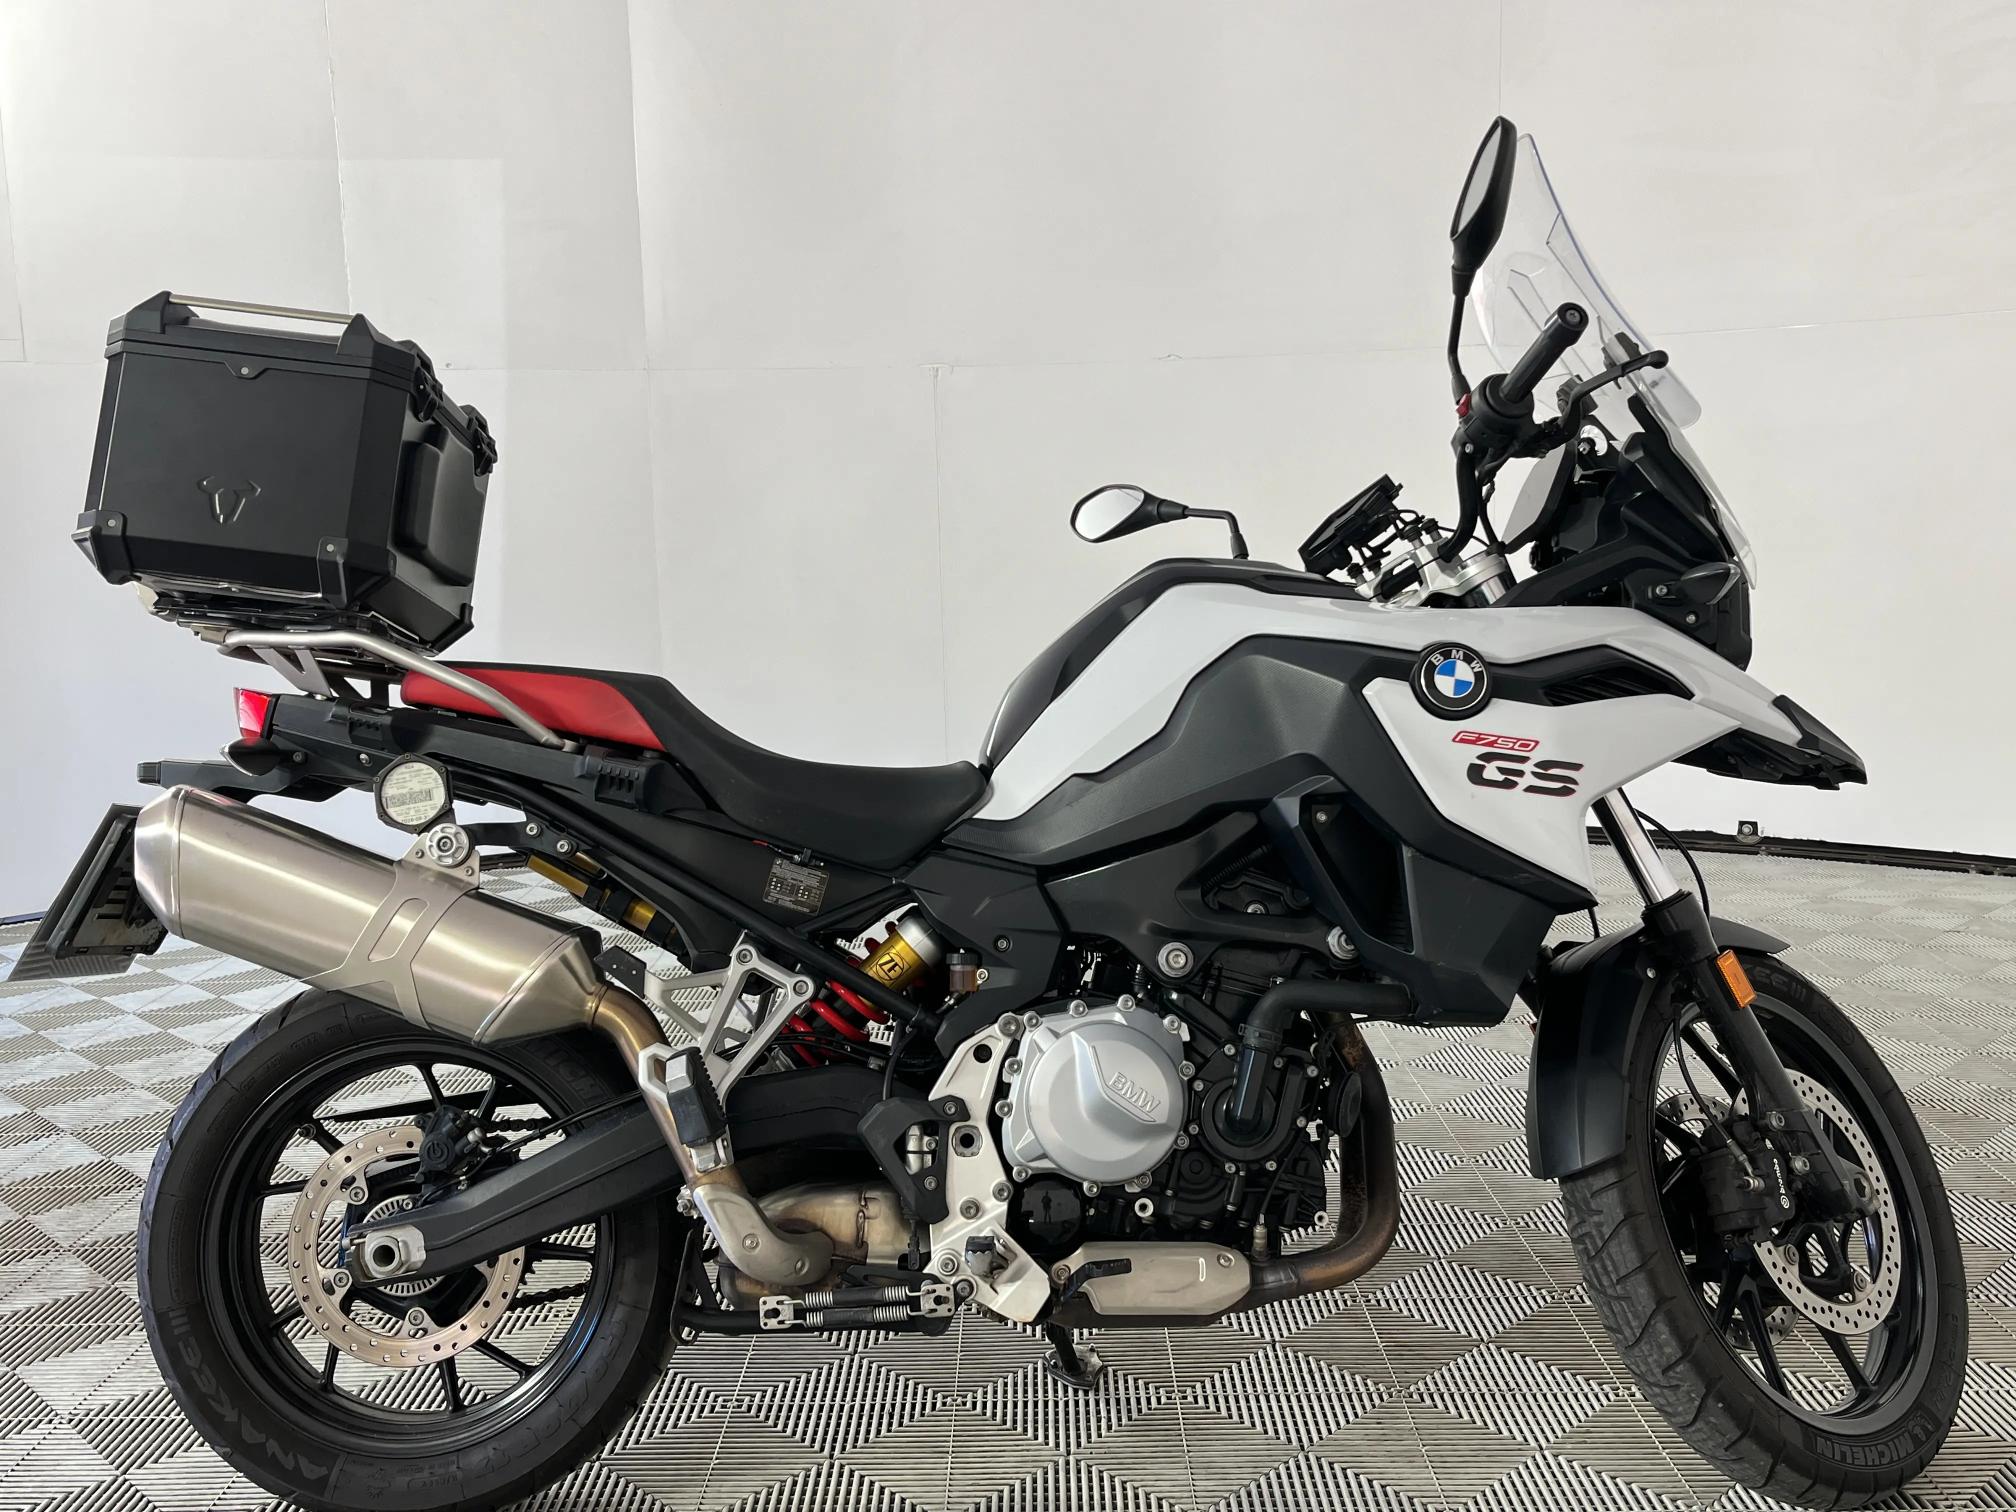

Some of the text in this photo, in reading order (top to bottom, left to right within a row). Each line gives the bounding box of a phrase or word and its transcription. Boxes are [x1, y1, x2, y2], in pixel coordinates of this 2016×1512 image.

[1431, 649, 1484, 673] BMW
[1455, 732, 1537, 751] F750
[1467, 751, 1584, 798] GS
[878, 953, 904, 980] ZF
[1109, 1071, 1161, 1113] BMW
[178, 1336, 328, 1480] ANAKEE
[1816, 1431, 1915, 1465] MICHELIN
